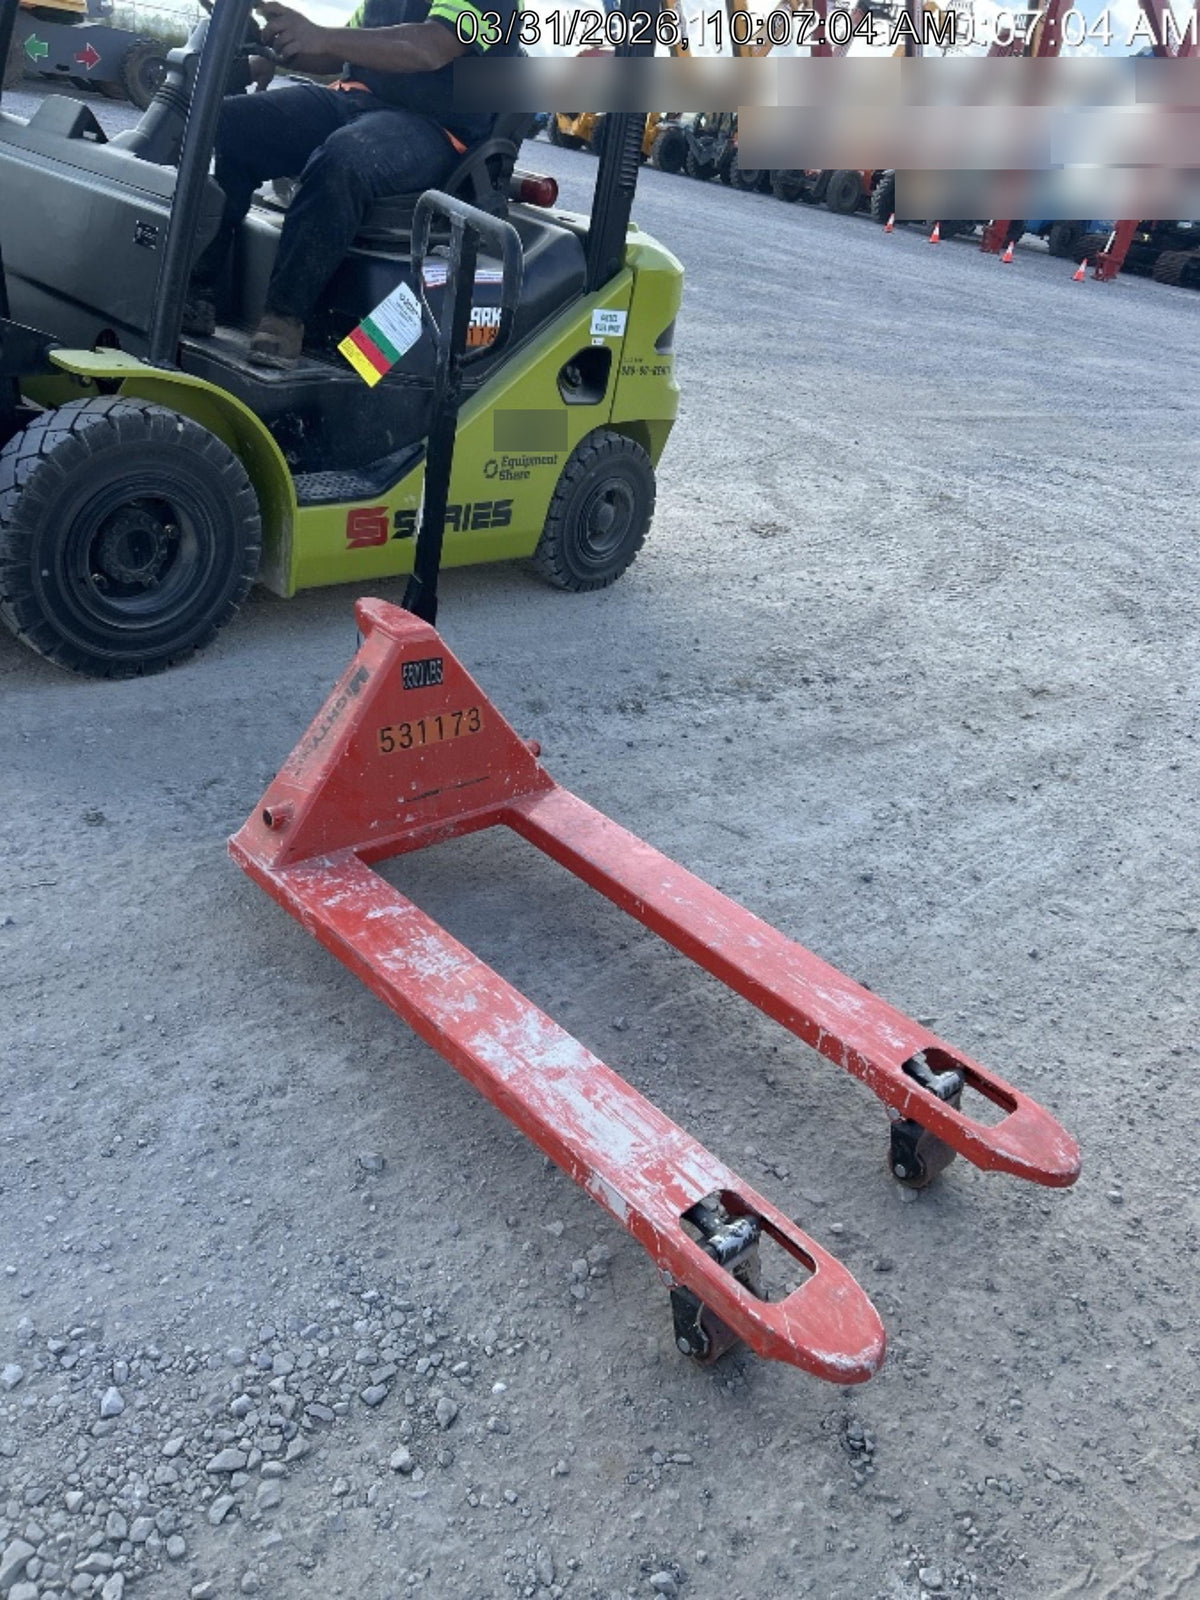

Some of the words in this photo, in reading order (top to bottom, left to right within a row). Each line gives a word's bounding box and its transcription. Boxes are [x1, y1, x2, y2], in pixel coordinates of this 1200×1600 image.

[500, 468, 531, 481] Share
[501, 453, 558, 468] Equipment
[391, 499, 514, 540] SRIES
[380, 707, 481, 753] 531173
